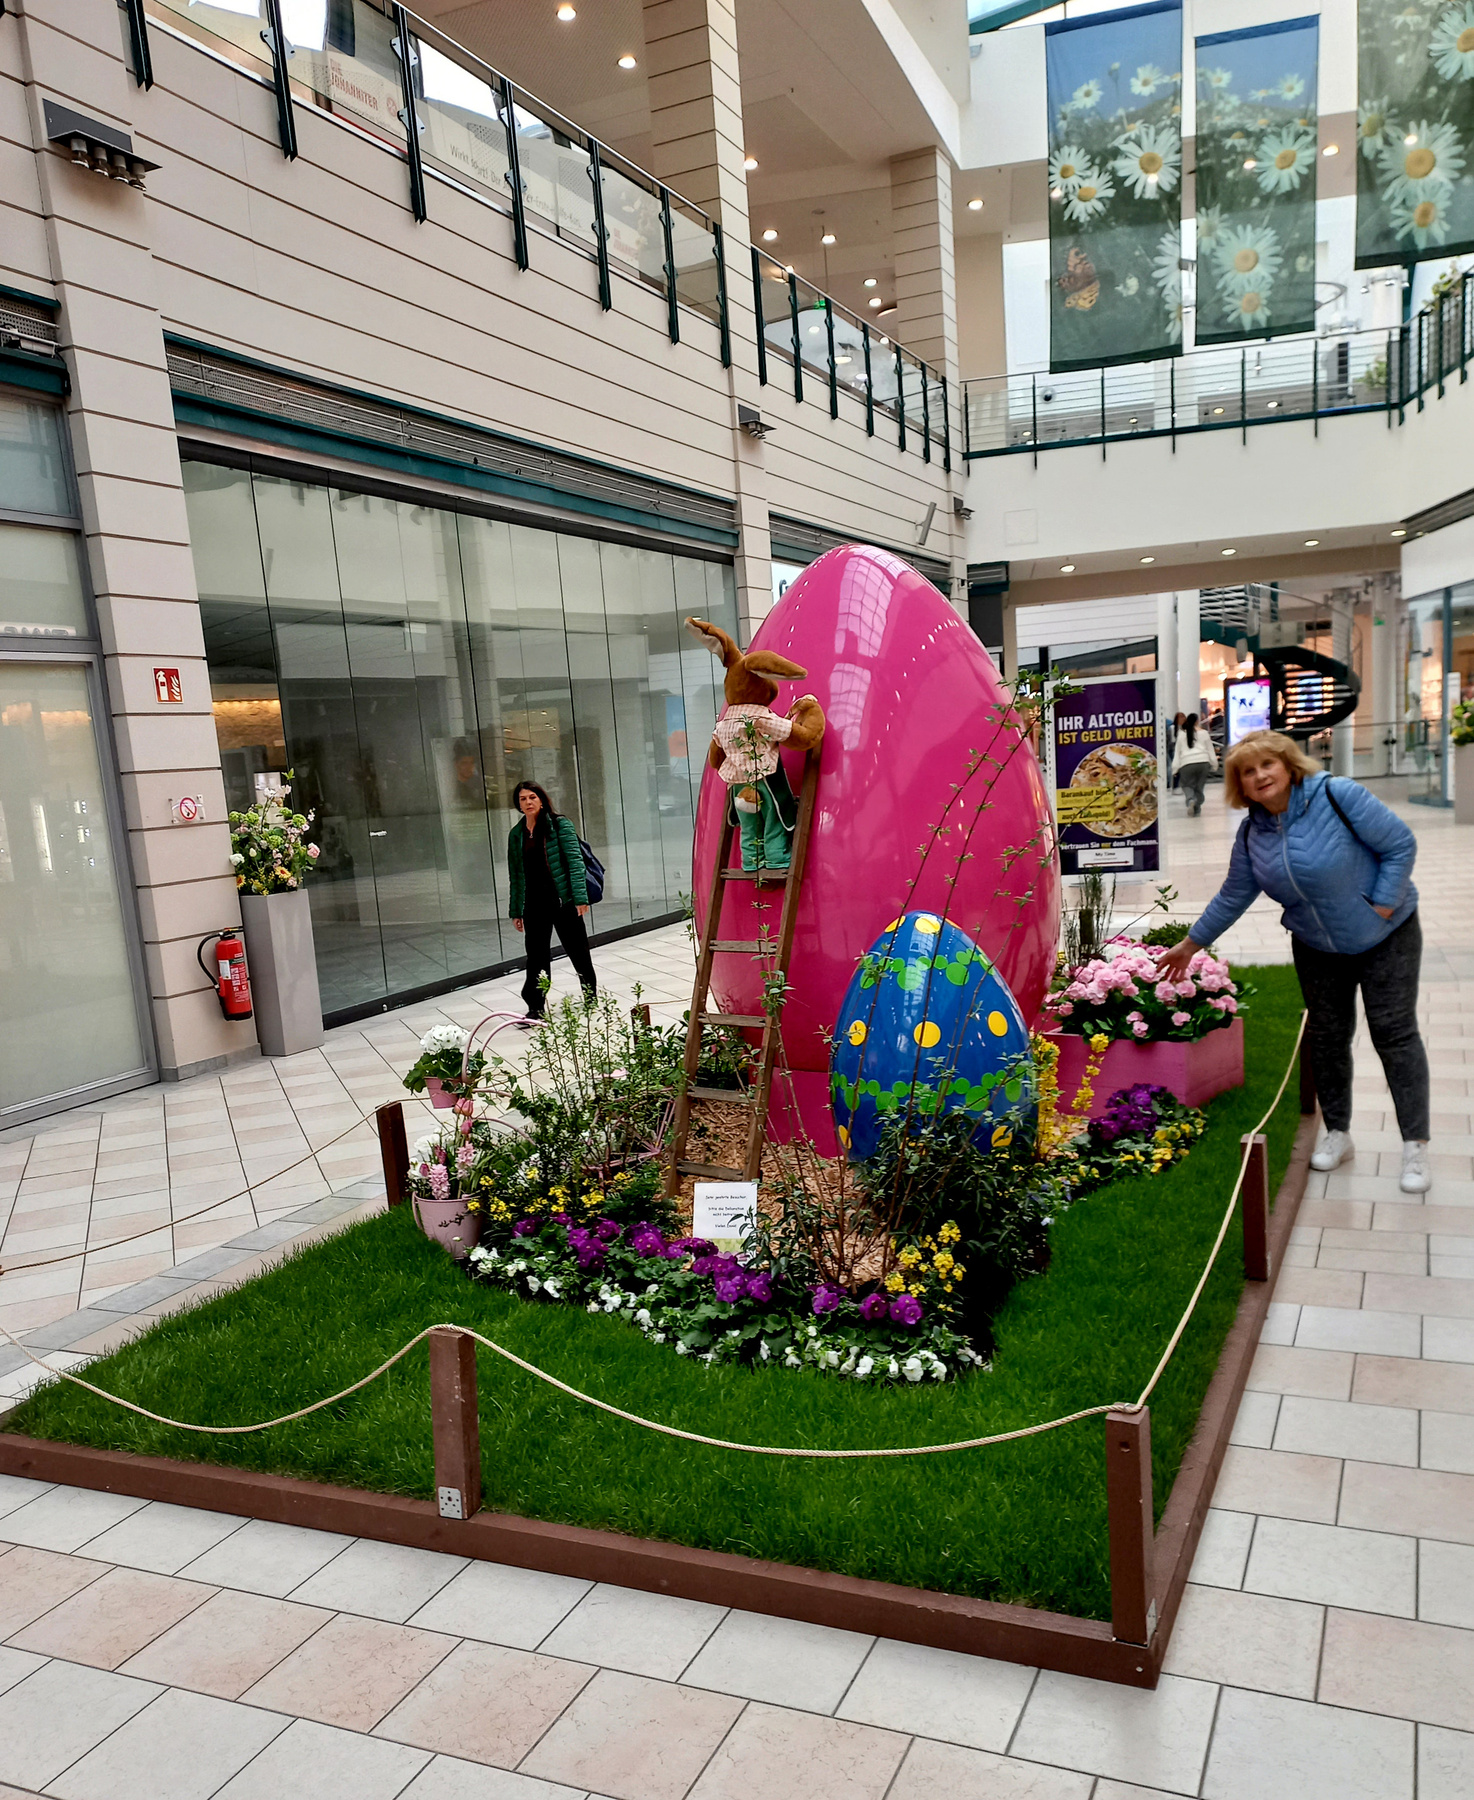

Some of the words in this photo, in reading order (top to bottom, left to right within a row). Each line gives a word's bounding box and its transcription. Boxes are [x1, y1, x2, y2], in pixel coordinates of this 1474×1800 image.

[330, 72, 379, 111] JOHANNITER
[450, 144, 469, 164] Wirkt
[1058, 715, 1084, 731] IHR
[1088, 710, 1154, 729] ALTGOLD
[1059, 732, 1078, 744] IST
[1081, 729, 1112, 742] GELD
[1116, 726, 1154, 740] WERT!
